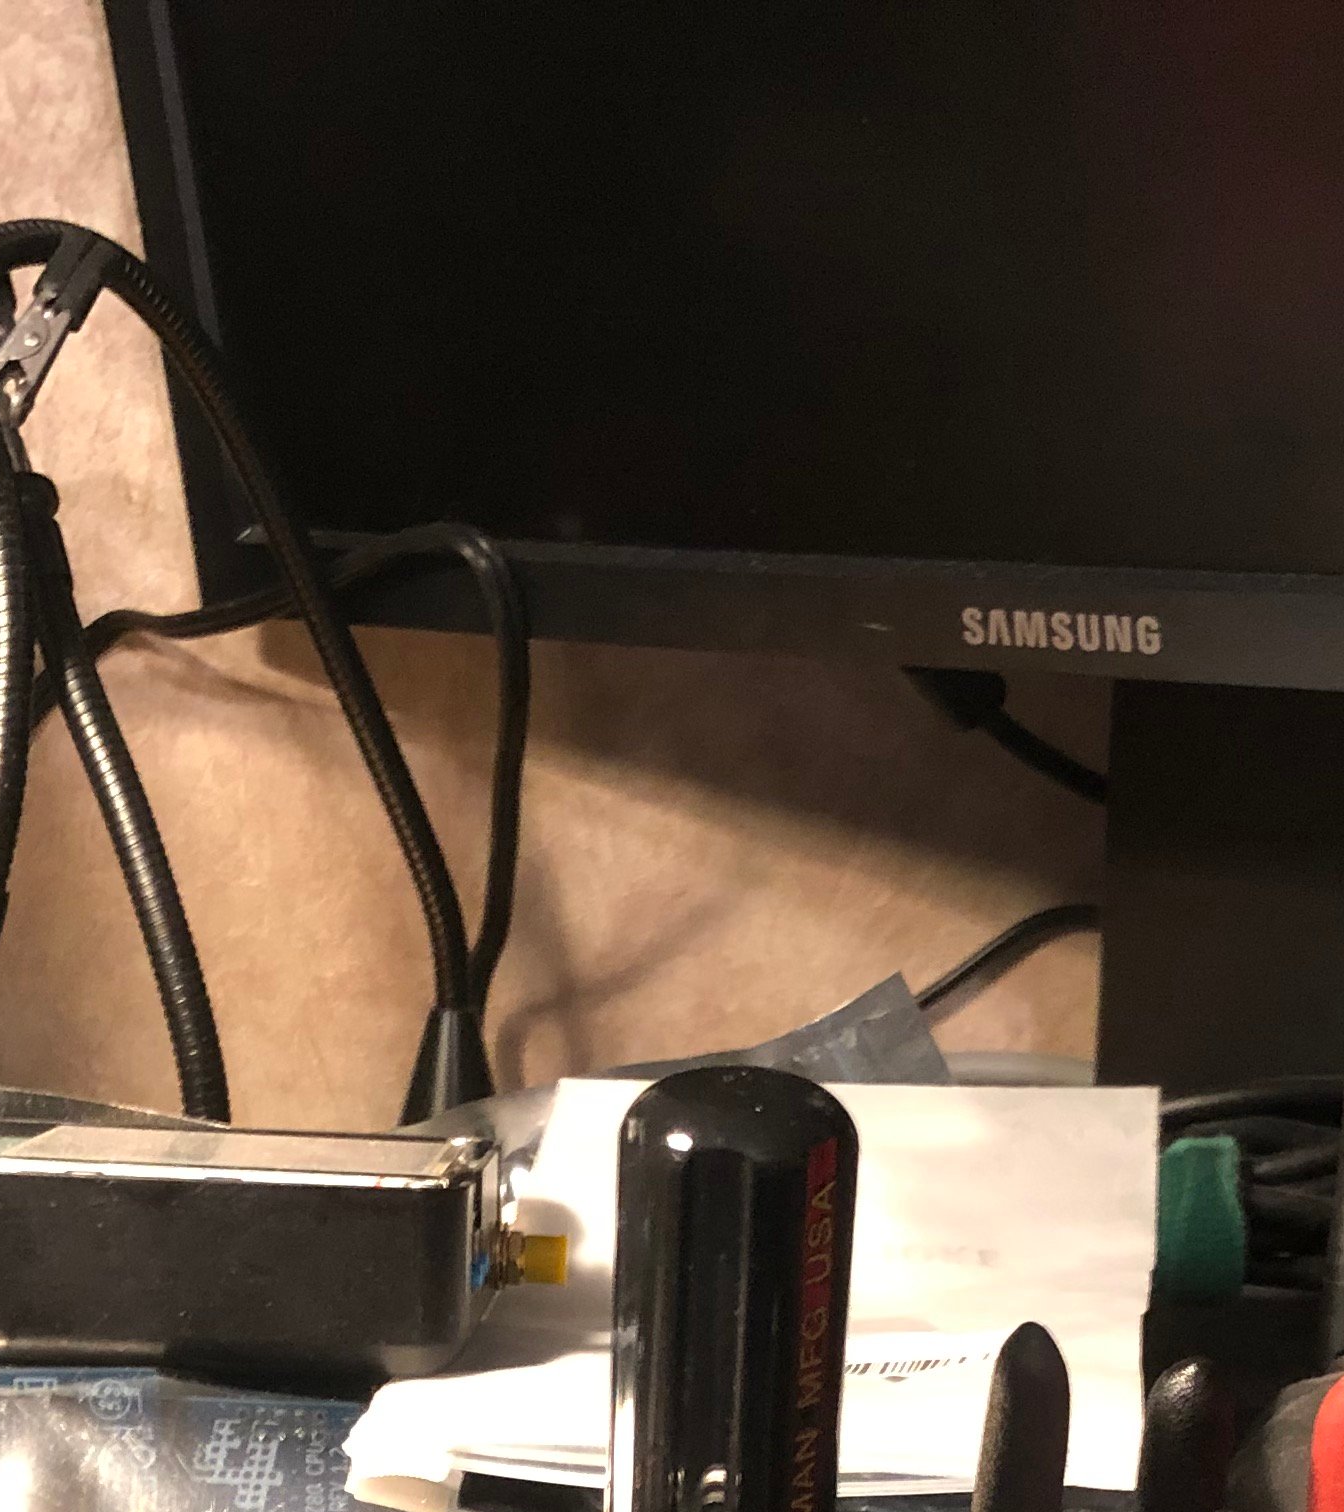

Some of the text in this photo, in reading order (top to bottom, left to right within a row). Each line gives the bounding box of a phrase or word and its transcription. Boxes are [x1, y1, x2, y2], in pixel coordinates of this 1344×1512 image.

[961, 607, 1162, 655] SAMSUNG
[805, 1180, 838, 1285] USA
[794, 1305, 831, 1409] MFG
